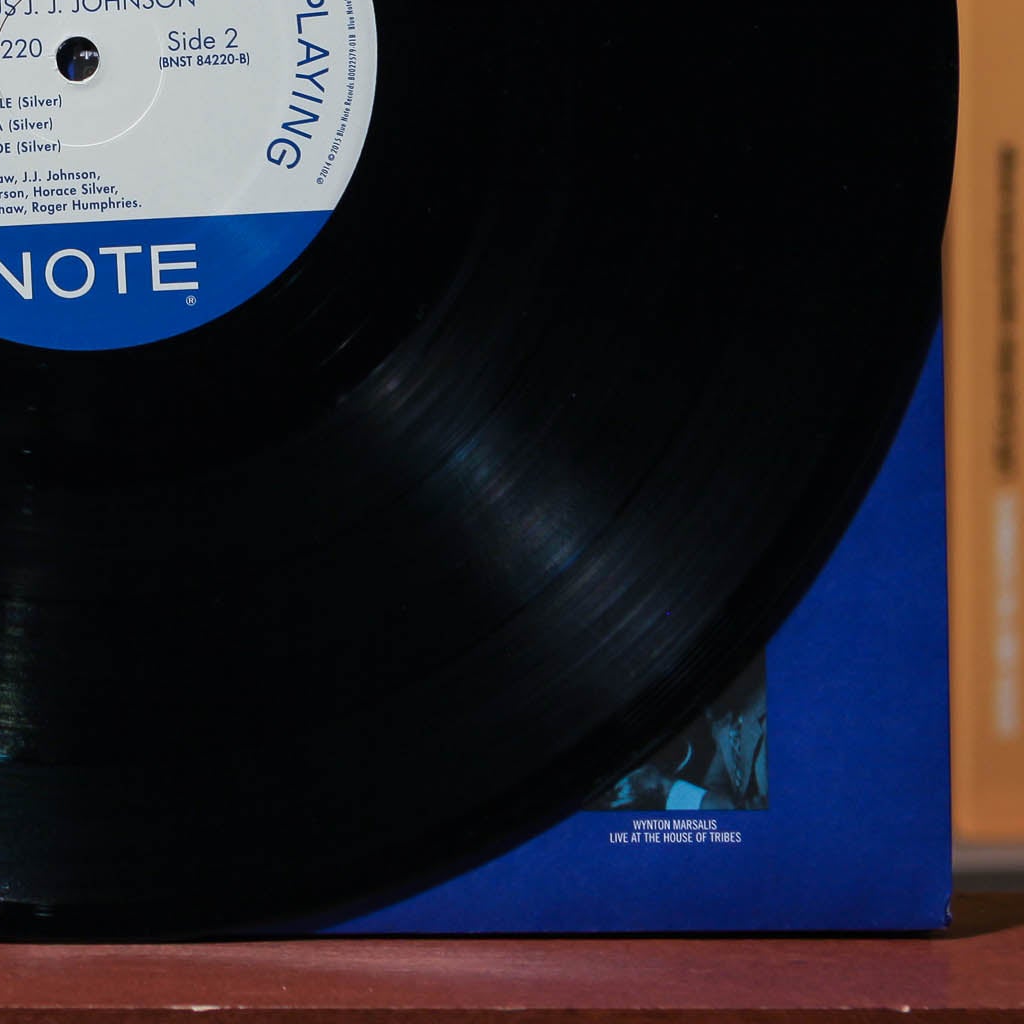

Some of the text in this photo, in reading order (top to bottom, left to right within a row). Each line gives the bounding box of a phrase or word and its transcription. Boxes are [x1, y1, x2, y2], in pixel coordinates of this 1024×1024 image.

[346, 16, 355, 29] Blue
[167, 28, 238, 52] Side 2
[158, 53, 250, 69] (BNST 84220-B)
[343, 82, 354, 105] Records
[18, 95, 63, 110] (Silver)
[340, 107, 350, 121] Note
[8, 117, 53, 133] (Silver)
[335, 122, 346, 136] Blue
[16, 140, 62, 155] (Silver)
[22, 171, 42, 183] J.J.
[46, 169, 101, 182] Johnson,
[33, 185, 77, 198] Horace
[81, 184, 118, 196] Silver,
[32, 201, 68, 215] Roger
[72, 198, 142, 212] Humphries.
[633, 819, 717, 830] WYNTON MARSALIS
[610, 832, 742, 843] LIVE AT THE HOUSE OF TRIBES
